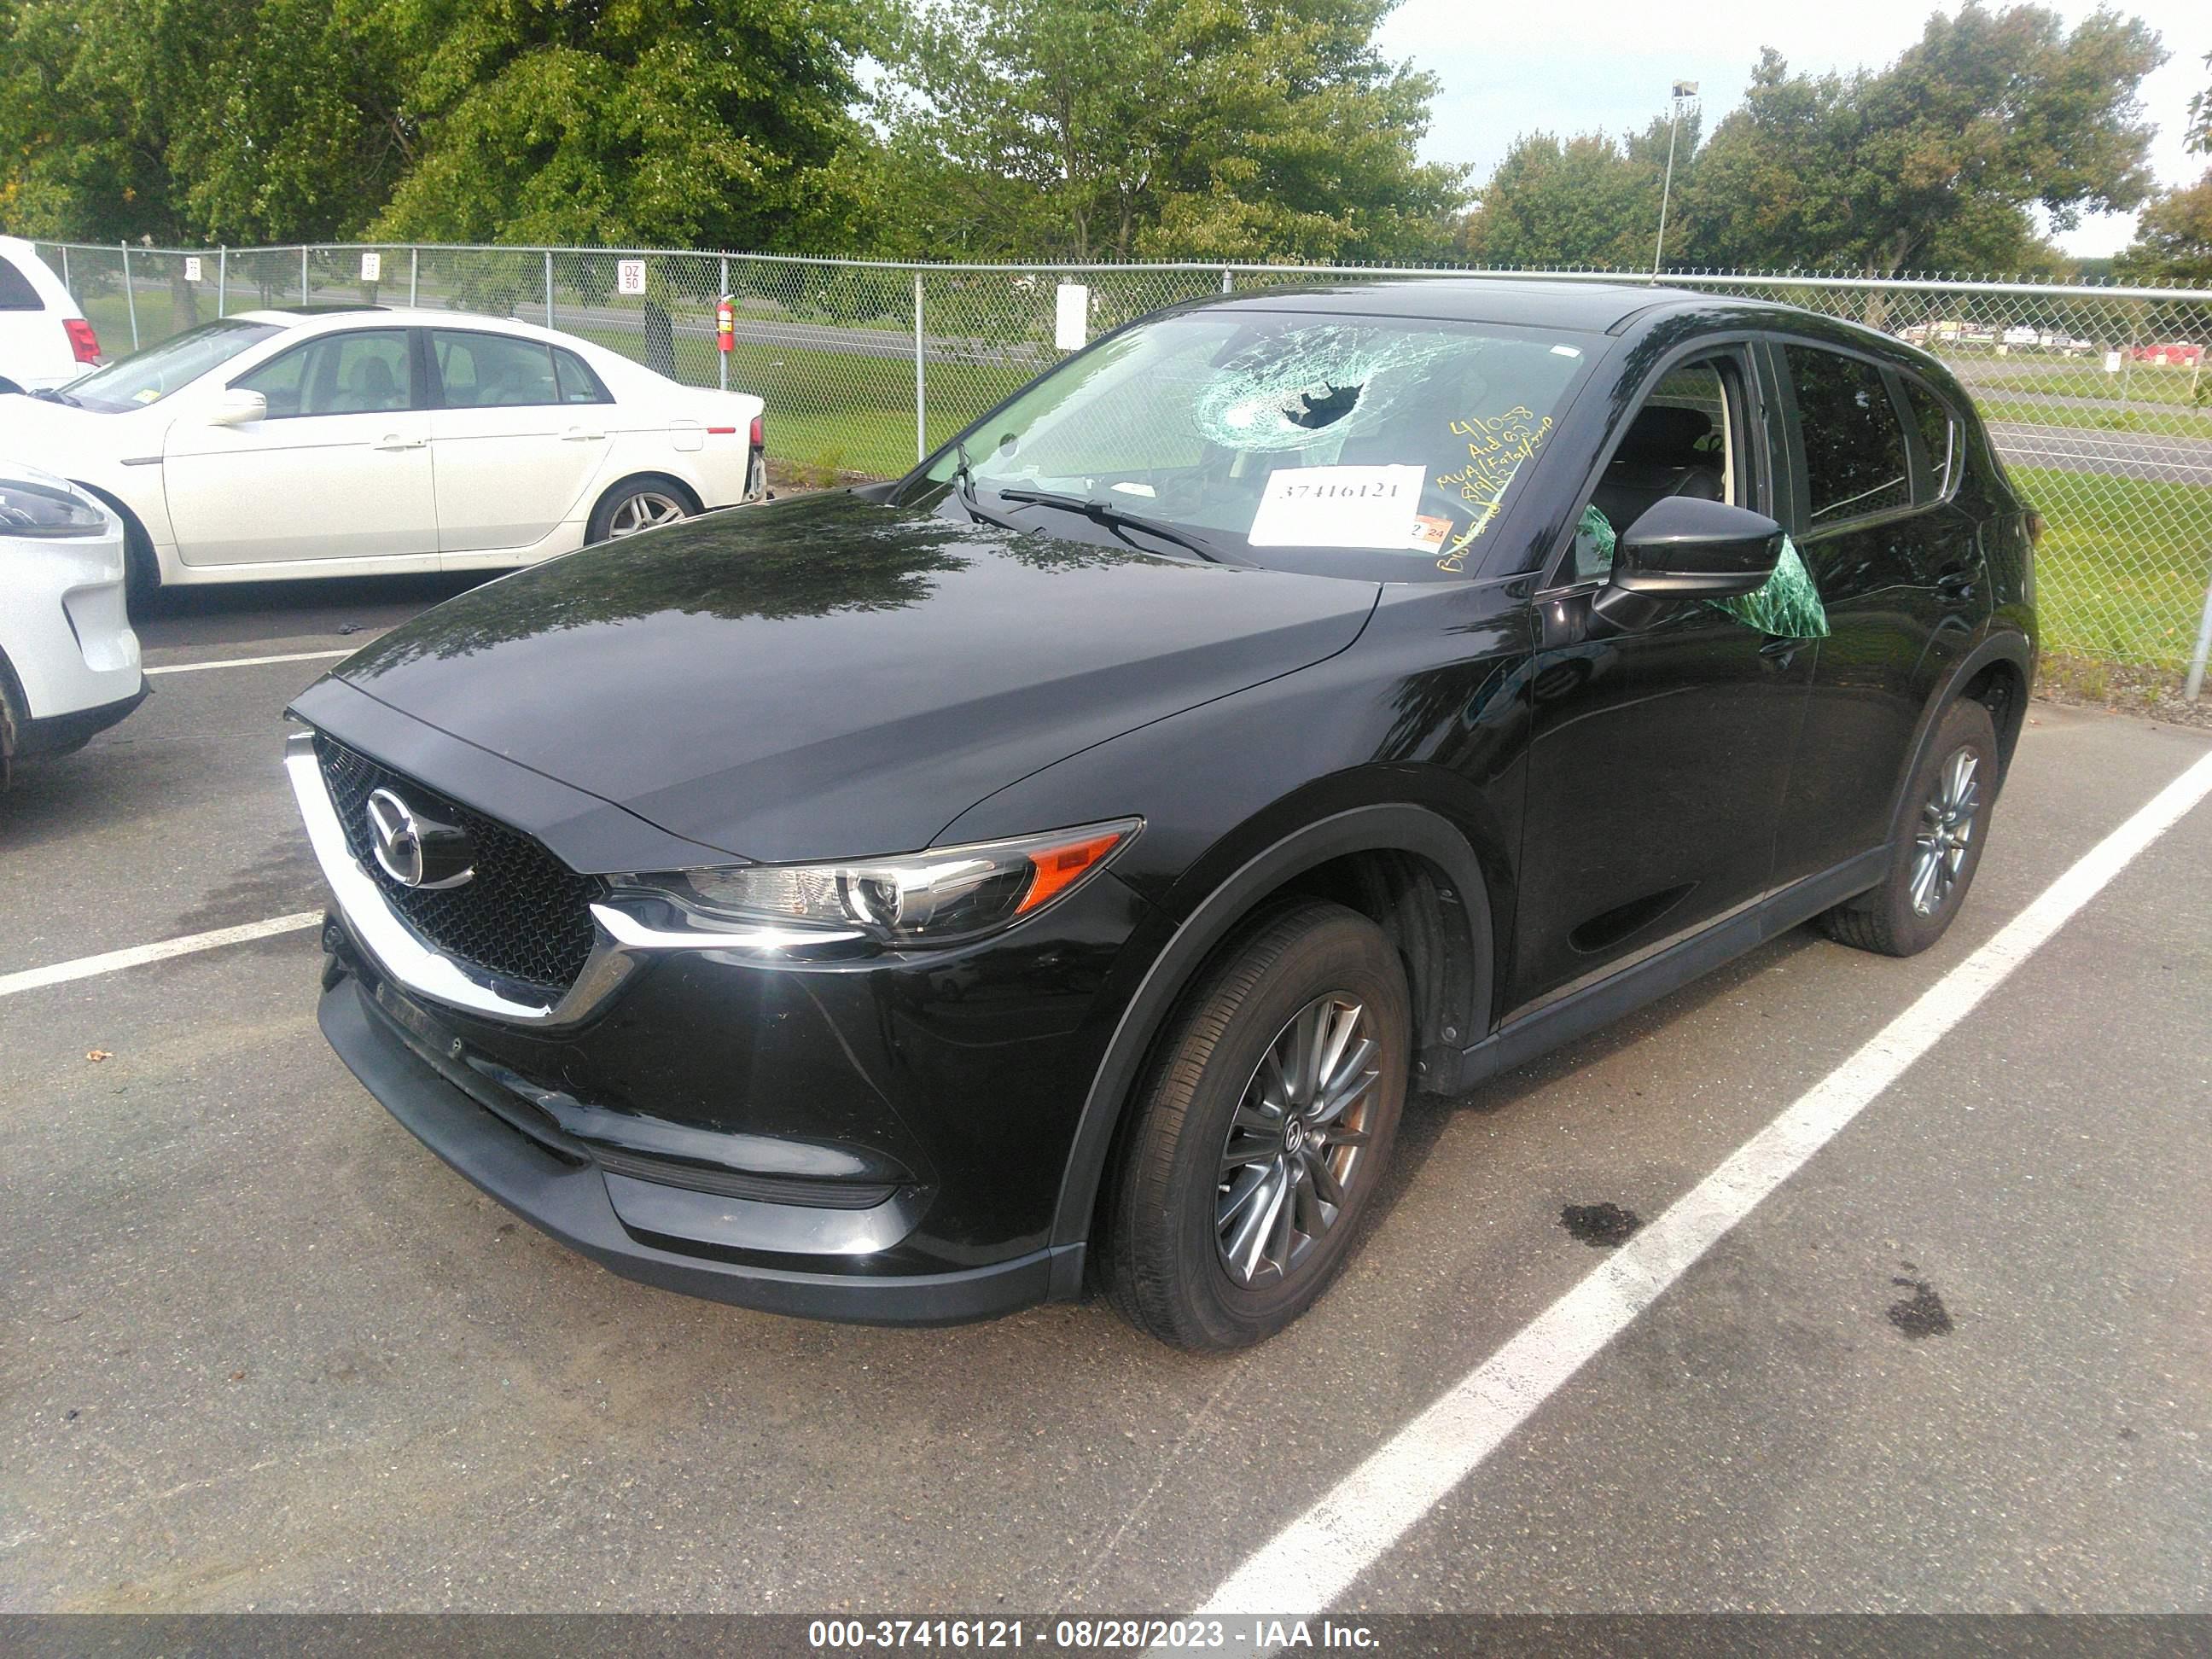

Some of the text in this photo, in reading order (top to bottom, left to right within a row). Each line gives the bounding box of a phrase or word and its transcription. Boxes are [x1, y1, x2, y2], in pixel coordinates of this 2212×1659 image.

[625, 265, 638, 276] DZ
[626, 277, 638, 288] 50
[1279, 482, 1398, 499] 37416121
[1428, 528, 1444, 538] 24
